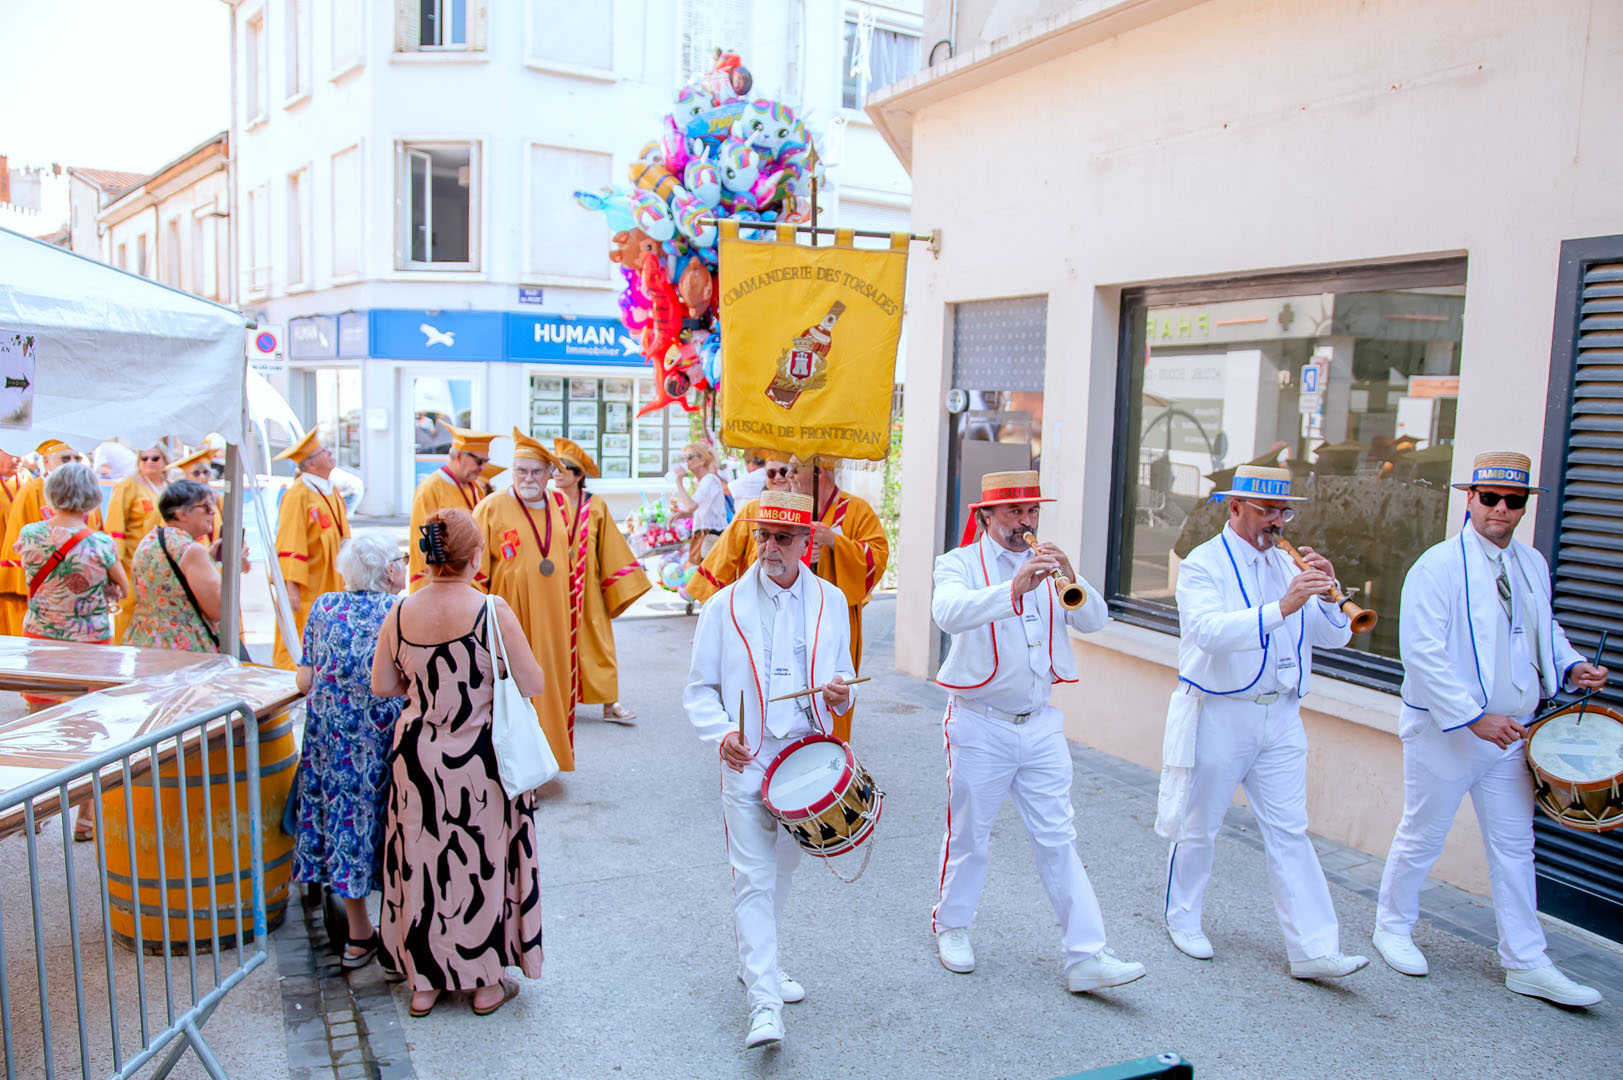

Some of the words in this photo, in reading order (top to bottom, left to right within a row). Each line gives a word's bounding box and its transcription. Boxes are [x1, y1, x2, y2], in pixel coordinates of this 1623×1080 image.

[723, 266, 812, 307] COMMANDERIE
[816, 267, 841, 283] DES
[843, 273, 898, 316] TORSADES
[534, 322, 616, 346] HUMAN
[726, 419, 774, 435] MUSCAT
[777, 426, 795, 438] DE
[800, 426, 882, 445] FRONTIGNAN
[1477, 469, 1526, 481] TAMBOUR
